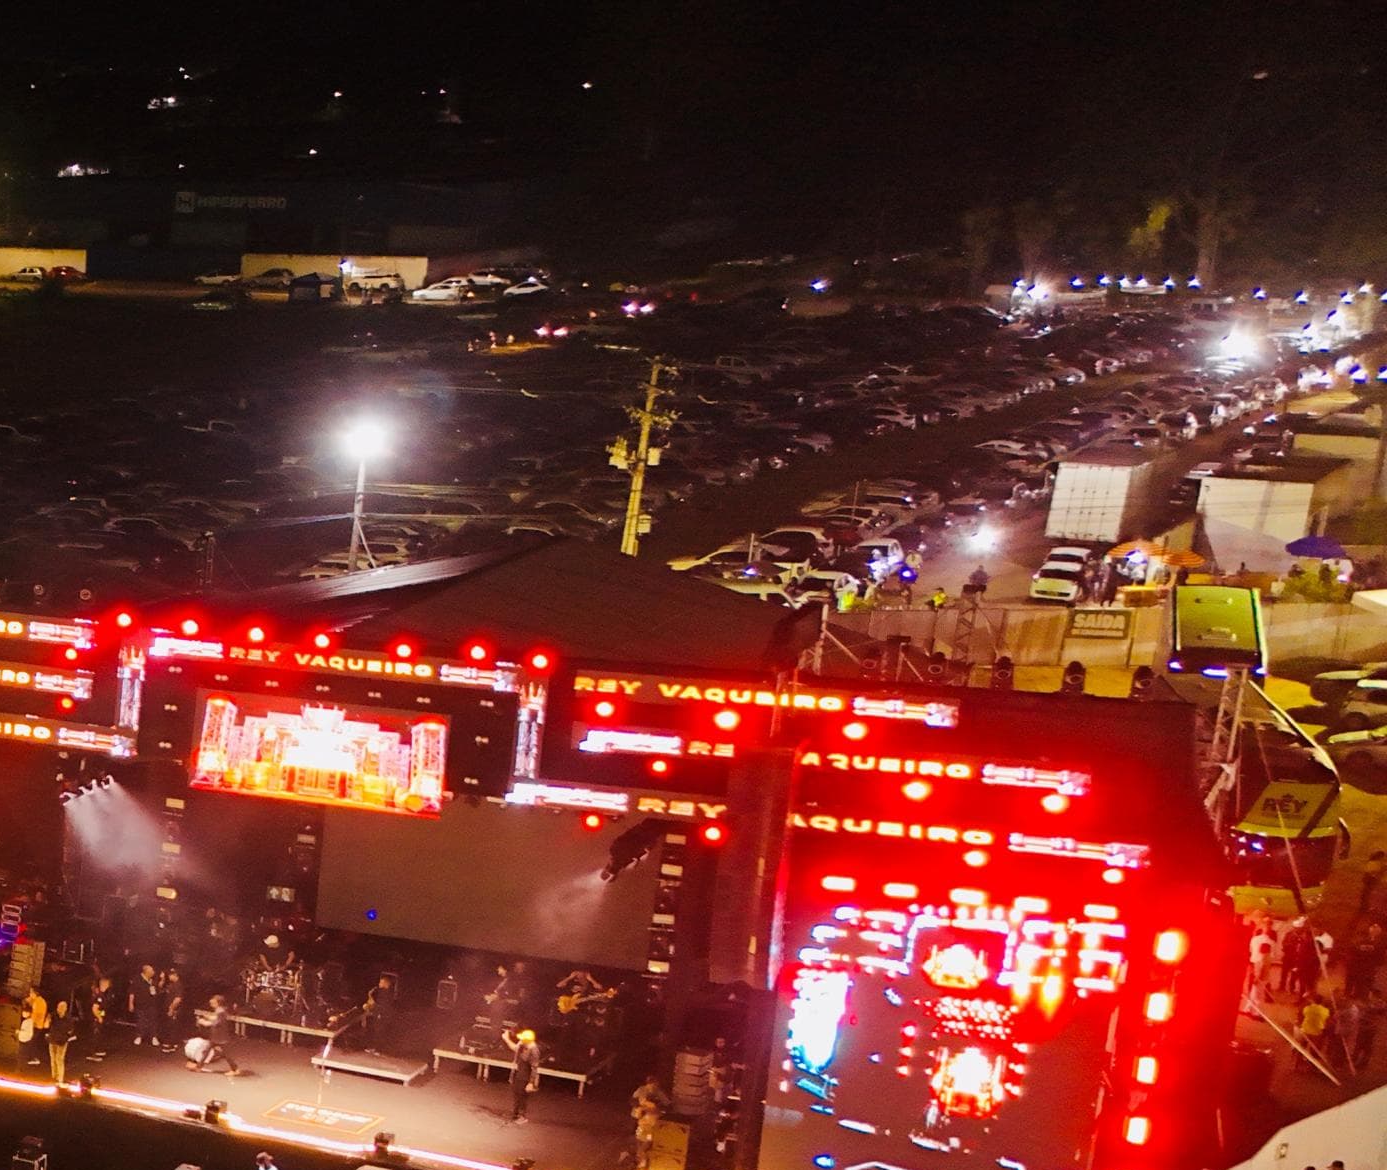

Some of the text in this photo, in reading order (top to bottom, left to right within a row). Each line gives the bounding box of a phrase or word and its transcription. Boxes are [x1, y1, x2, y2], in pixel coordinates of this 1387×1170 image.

[229, 646, 434, 678] REY VAQUEIRO
[573, 676, 845, 711] REY VAQUEIRO
[687, 740, 973, 779] RE AQUEIRO
[637, 796, 728, 819] REY
